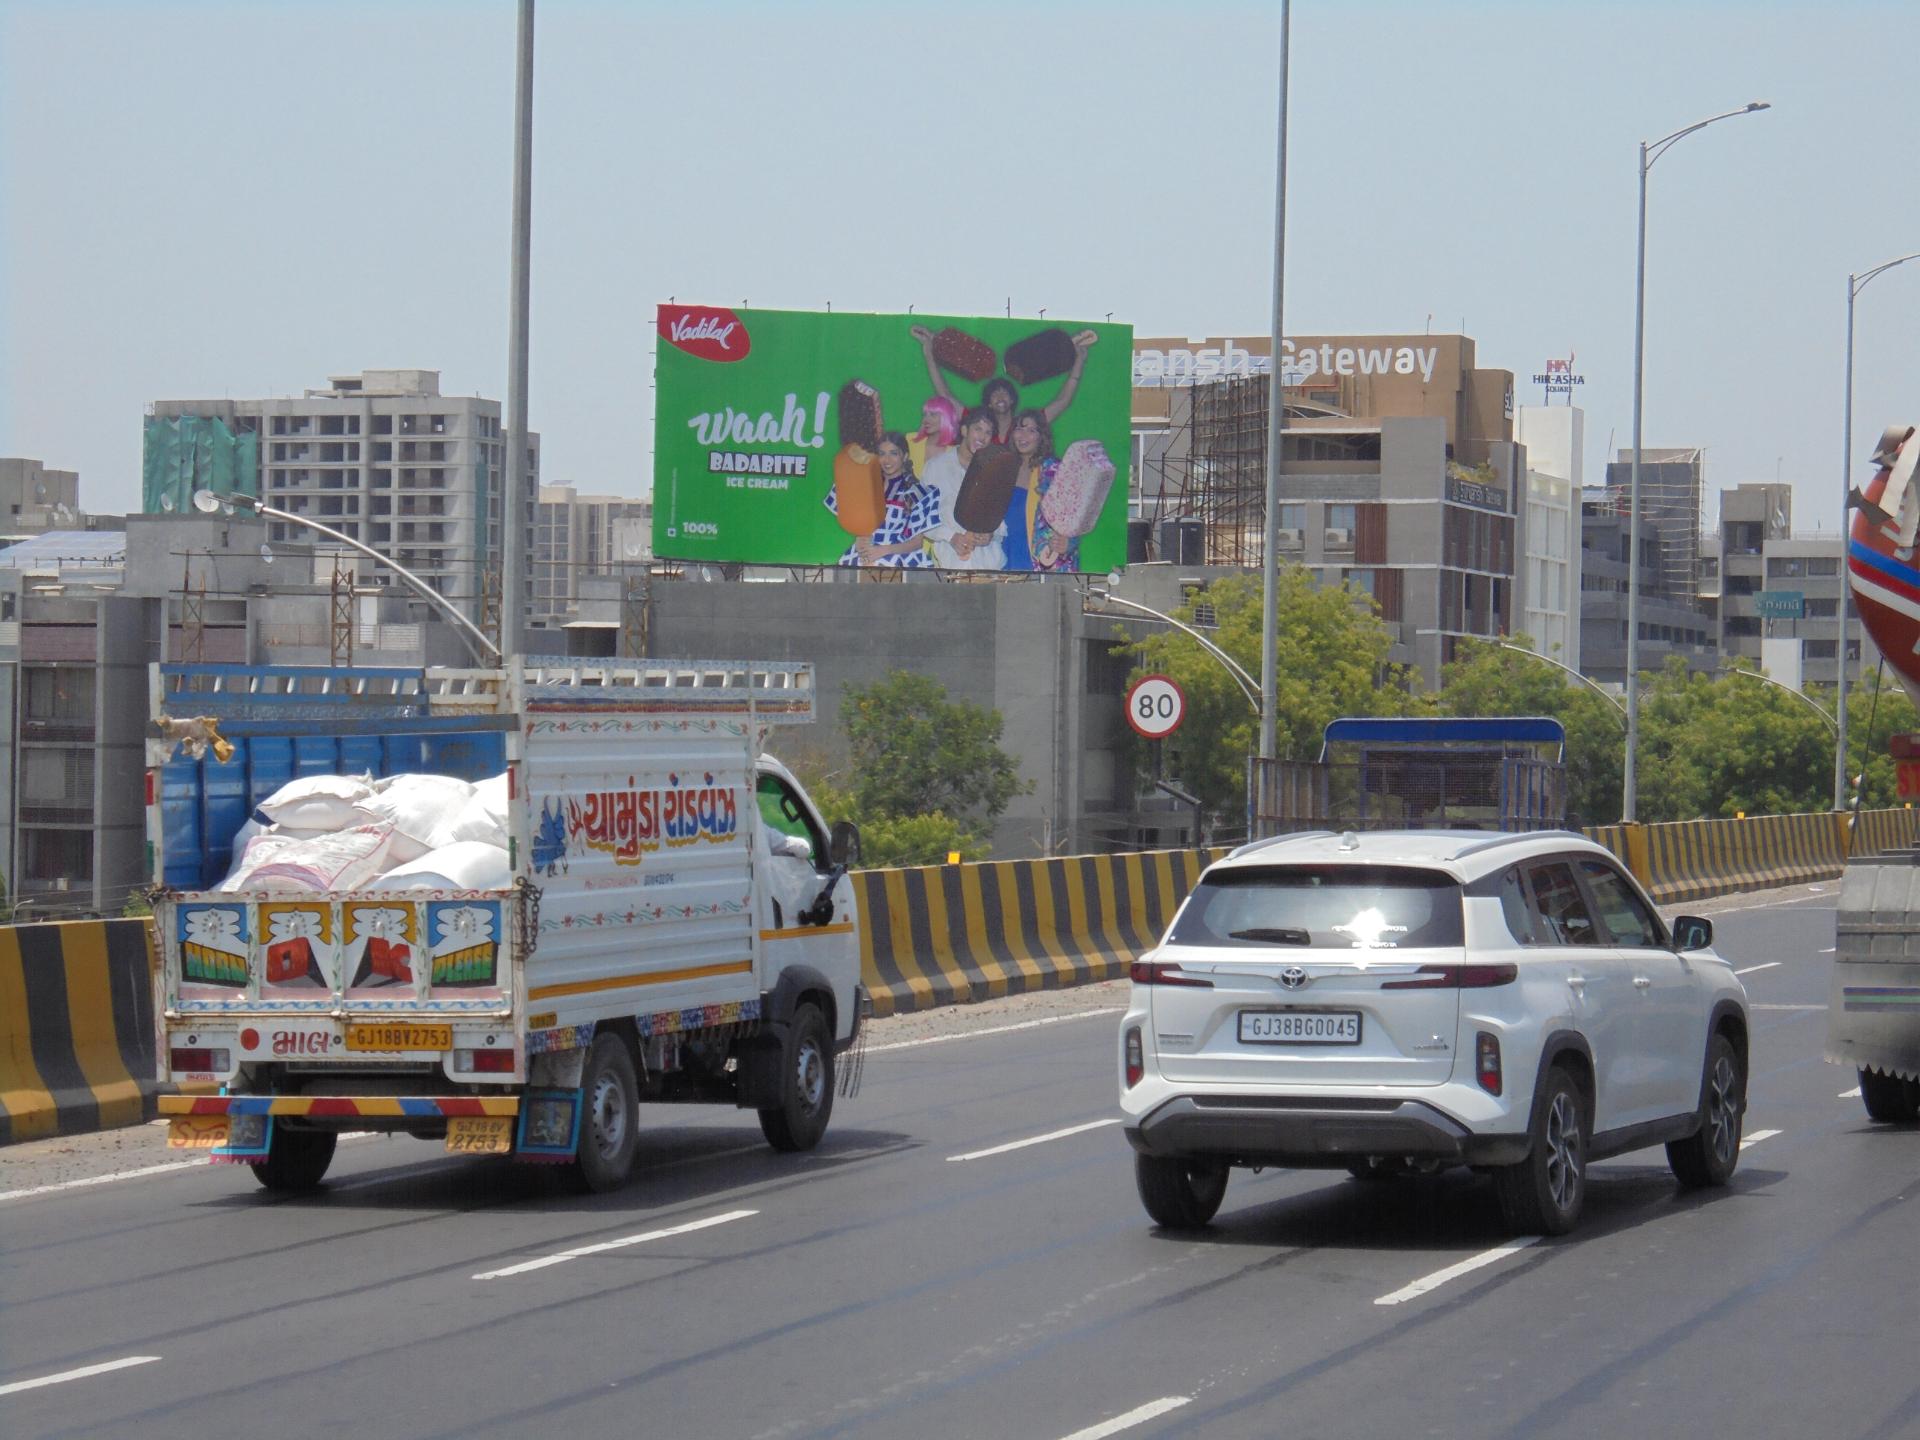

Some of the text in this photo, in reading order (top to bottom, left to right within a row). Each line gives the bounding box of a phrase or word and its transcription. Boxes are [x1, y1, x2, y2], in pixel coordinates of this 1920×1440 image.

[671, 314, 734, 350] Vadilal
[1133, 339, 1249, 377] ansh
[1533, 374, 1585, 385] HIR-ASHA
[688, 391, 830, 448] waah!
[710, 452, 807, 475] BADABITE
[726, 477, 789, 490] ICE CREAM
[682, 522, 718, 534] 100%
[1139, 694, 1173, 718] 80
[357, 1025, 449, 1047] GJ18BV2753
[1253, 1018, 1355, 1037] GJ38BG0045
[454, 1134, 500, 1151] 2753
